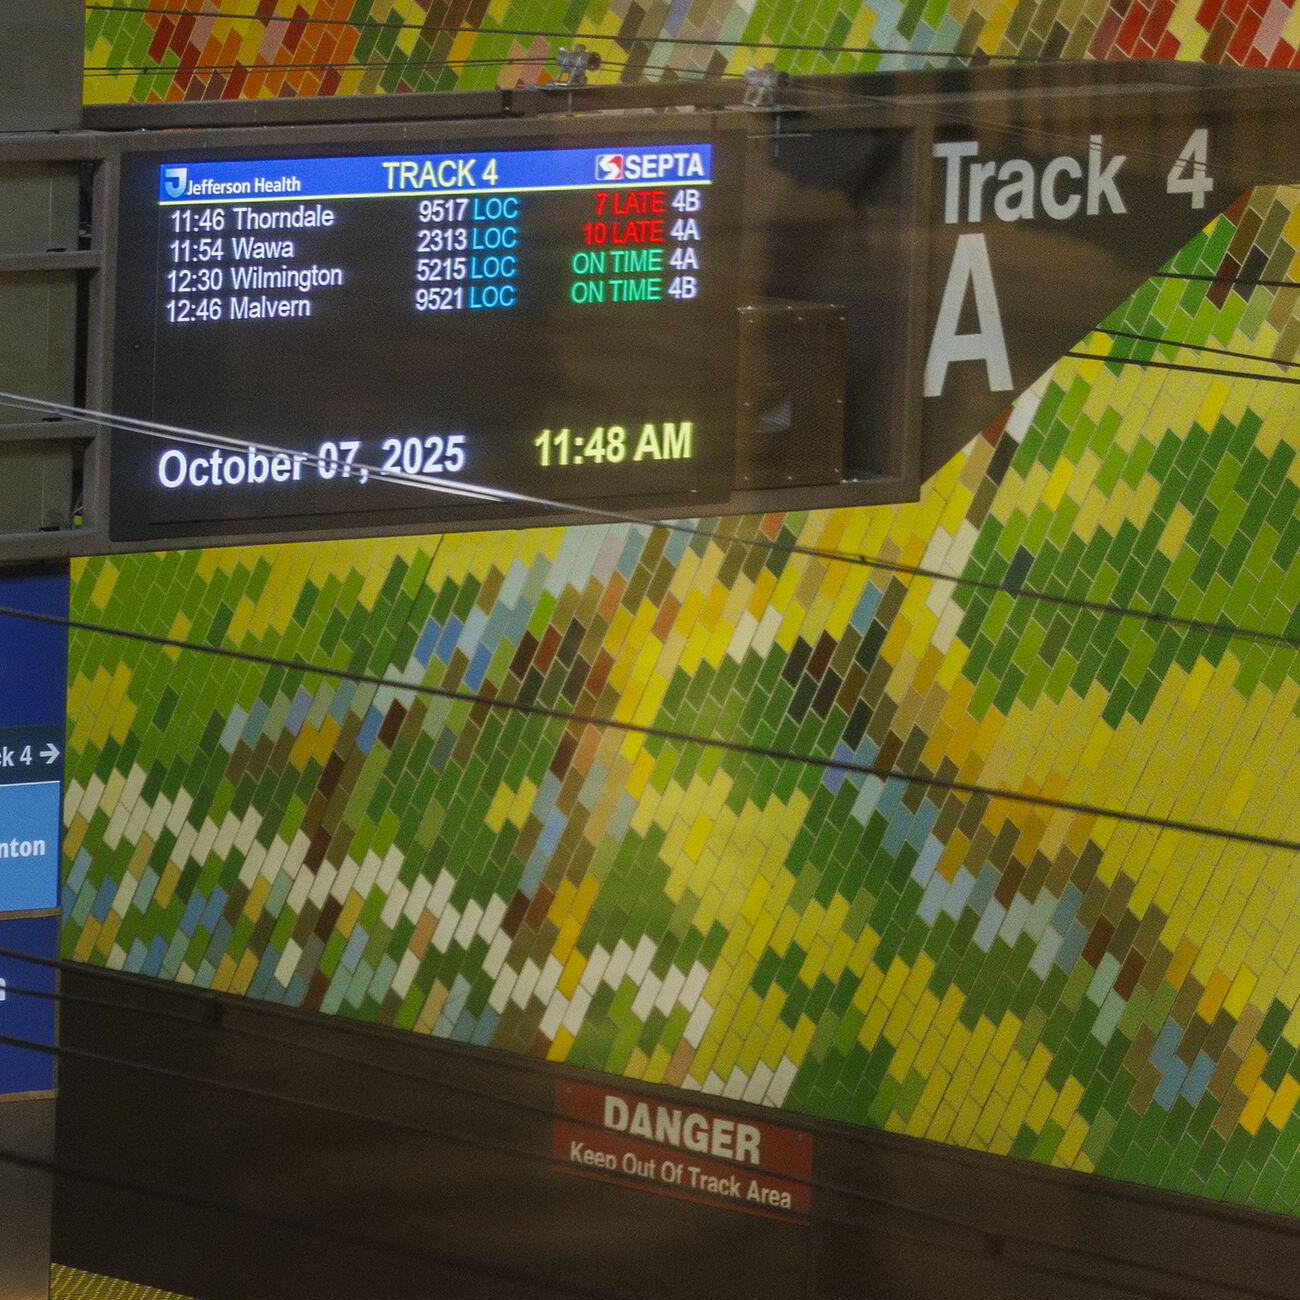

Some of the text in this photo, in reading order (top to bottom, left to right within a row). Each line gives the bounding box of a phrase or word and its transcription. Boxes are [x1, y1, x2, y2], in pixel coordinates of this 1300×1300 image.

[382, 158, 498, 189] TRACK 4
[625, 153, 704, 179] SEPTA
[933, 129, 1213, 224] Track 4
[186, 179, 250, 195] Jefferson
[254, 177, 301, 193] Health
[594, 189, 700, 215] 7 LATE 4B
[171, 197, 520, 232] 11:46 Thorndale 9517 LOC
[583, 218, 700, 244] 10 LATE 4A
[169, 227, 519, 262] 11:54 Wawa 2313 LOC
[572, 247, 699, 274] ON TIME 4A
[167, 256, 518, 292] 12:30 Wilmington 5215 LOC
[570, 276, 697, 304] ON TIME 4B
[166, 285, 516, 322] 12:46 Malvern 9521 LOC
[924, 233, 1014, 397] A
[158, 435, 465, 487] October 07, 2025
[535, 422, 693, 466] 11:48 AM
[19, 745, 32, 765] 4
[603, 1095, 761, 1165] DANGER
[570, 1141, 792, 1210] Keep Out Of Track Area
